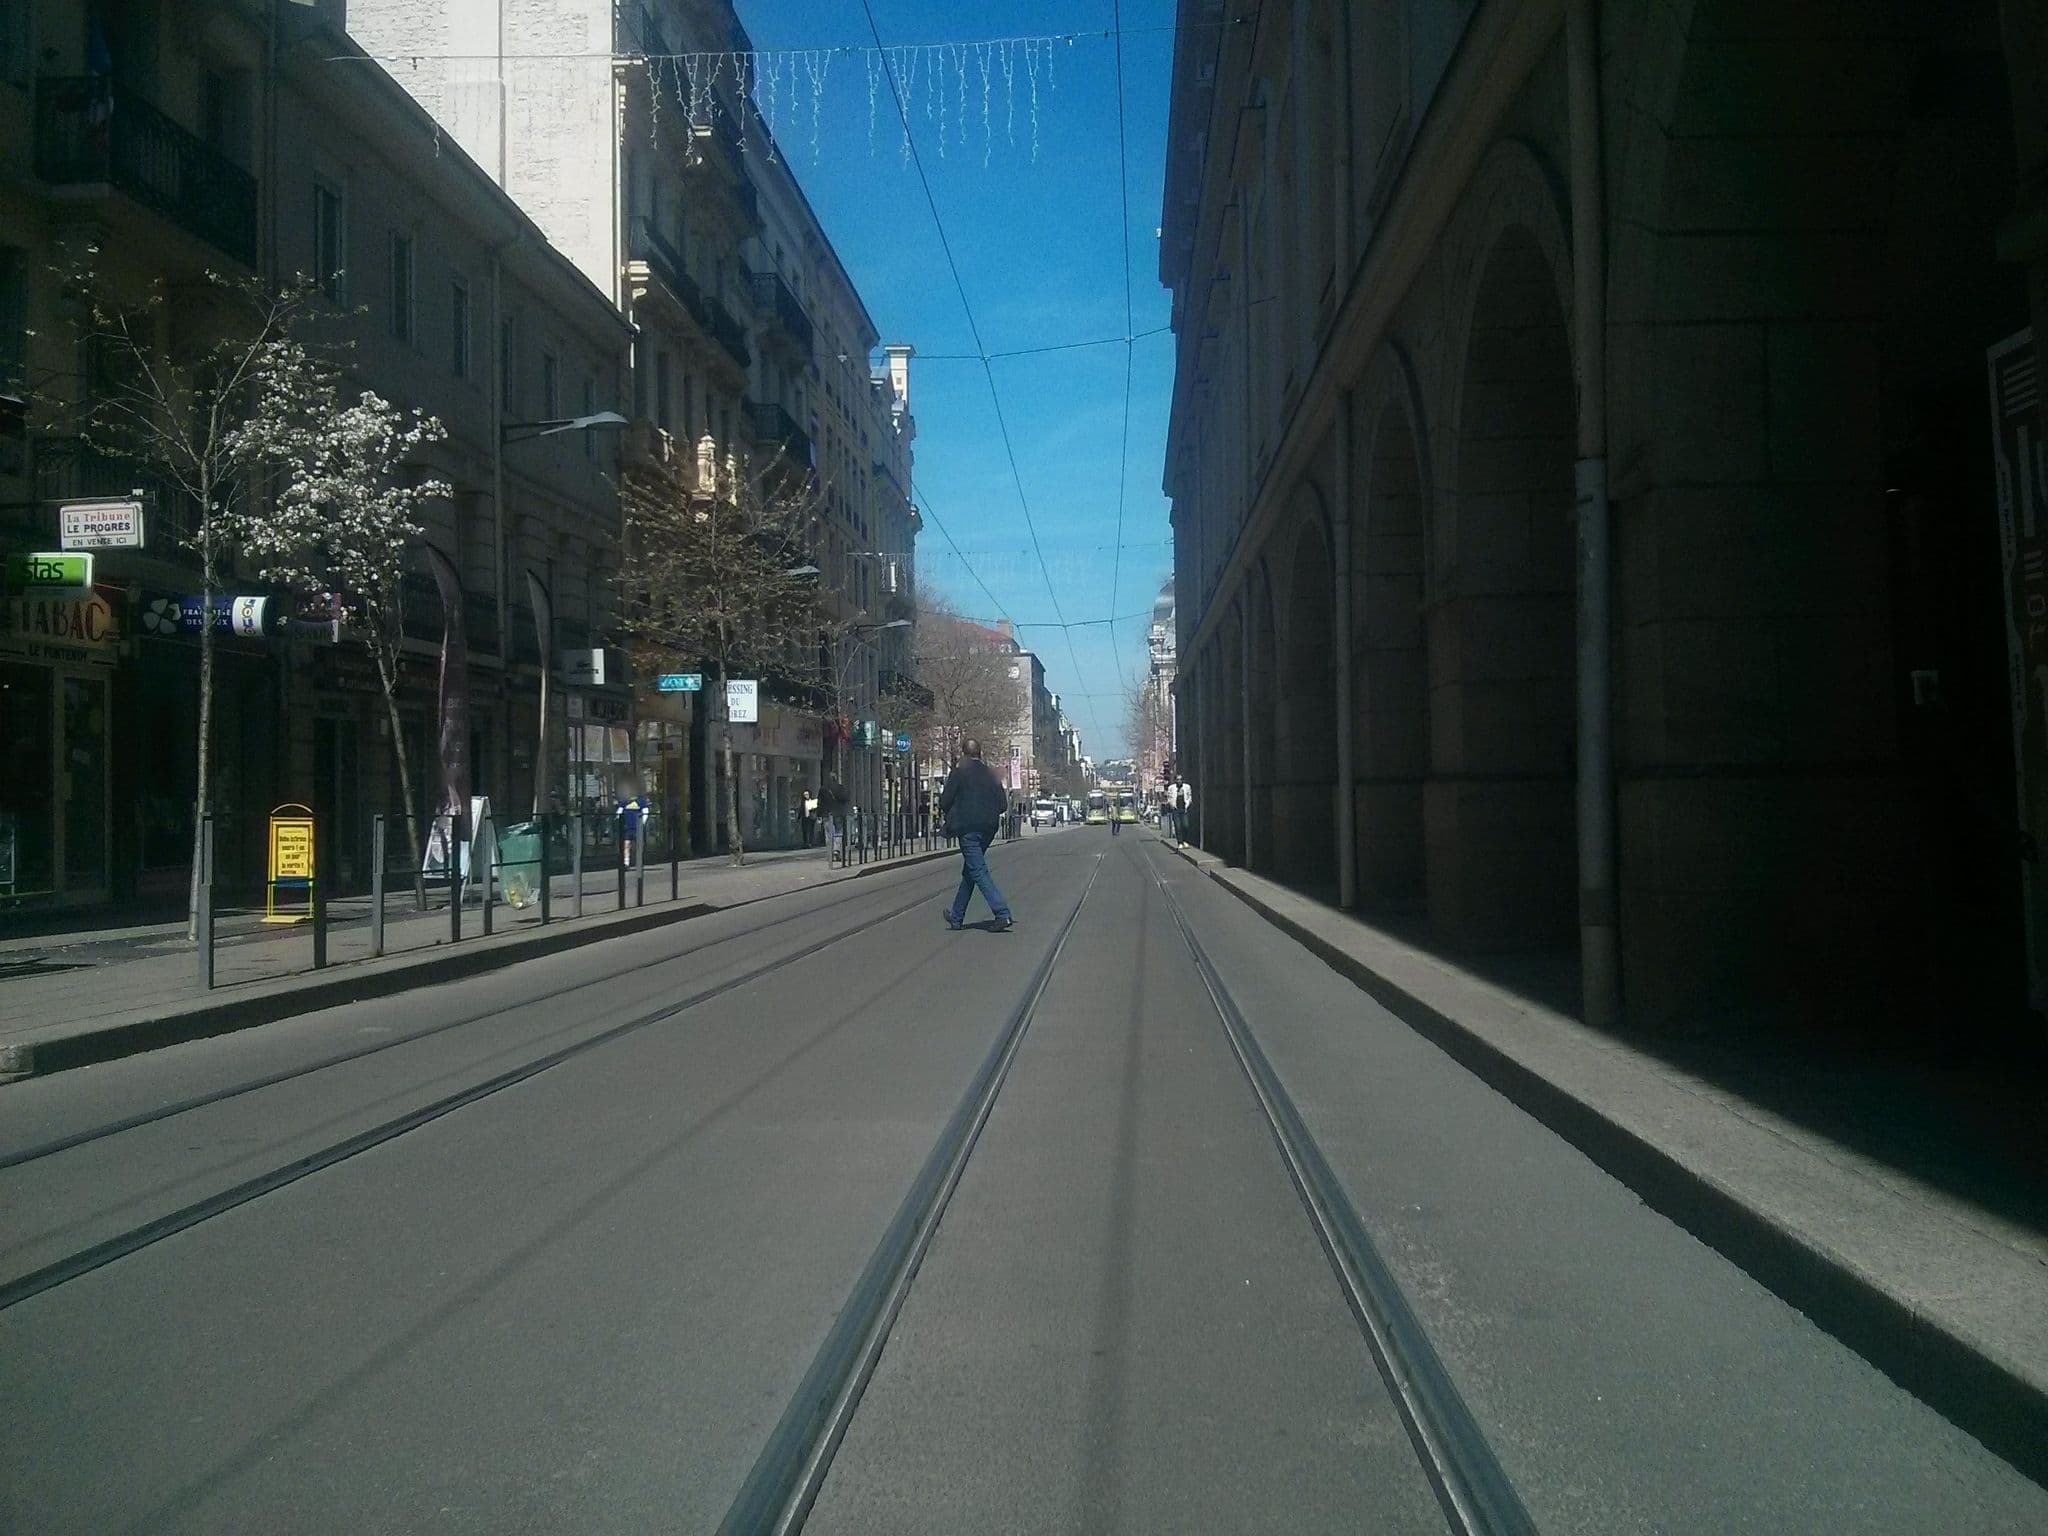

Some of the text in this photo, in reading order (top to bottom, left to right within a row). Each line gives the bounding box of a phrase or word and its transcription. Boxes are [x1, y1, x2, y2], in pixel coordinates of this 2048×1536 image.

[67, 511, 130, 523] La Tribune
[67, 525, 80, 533] LE
[88, 537, 113, 545] VENTE
[24, 557, 64, 581] stas
[21, 599, 105, 641] TABAC
[730, 697, 740, 706] DU
